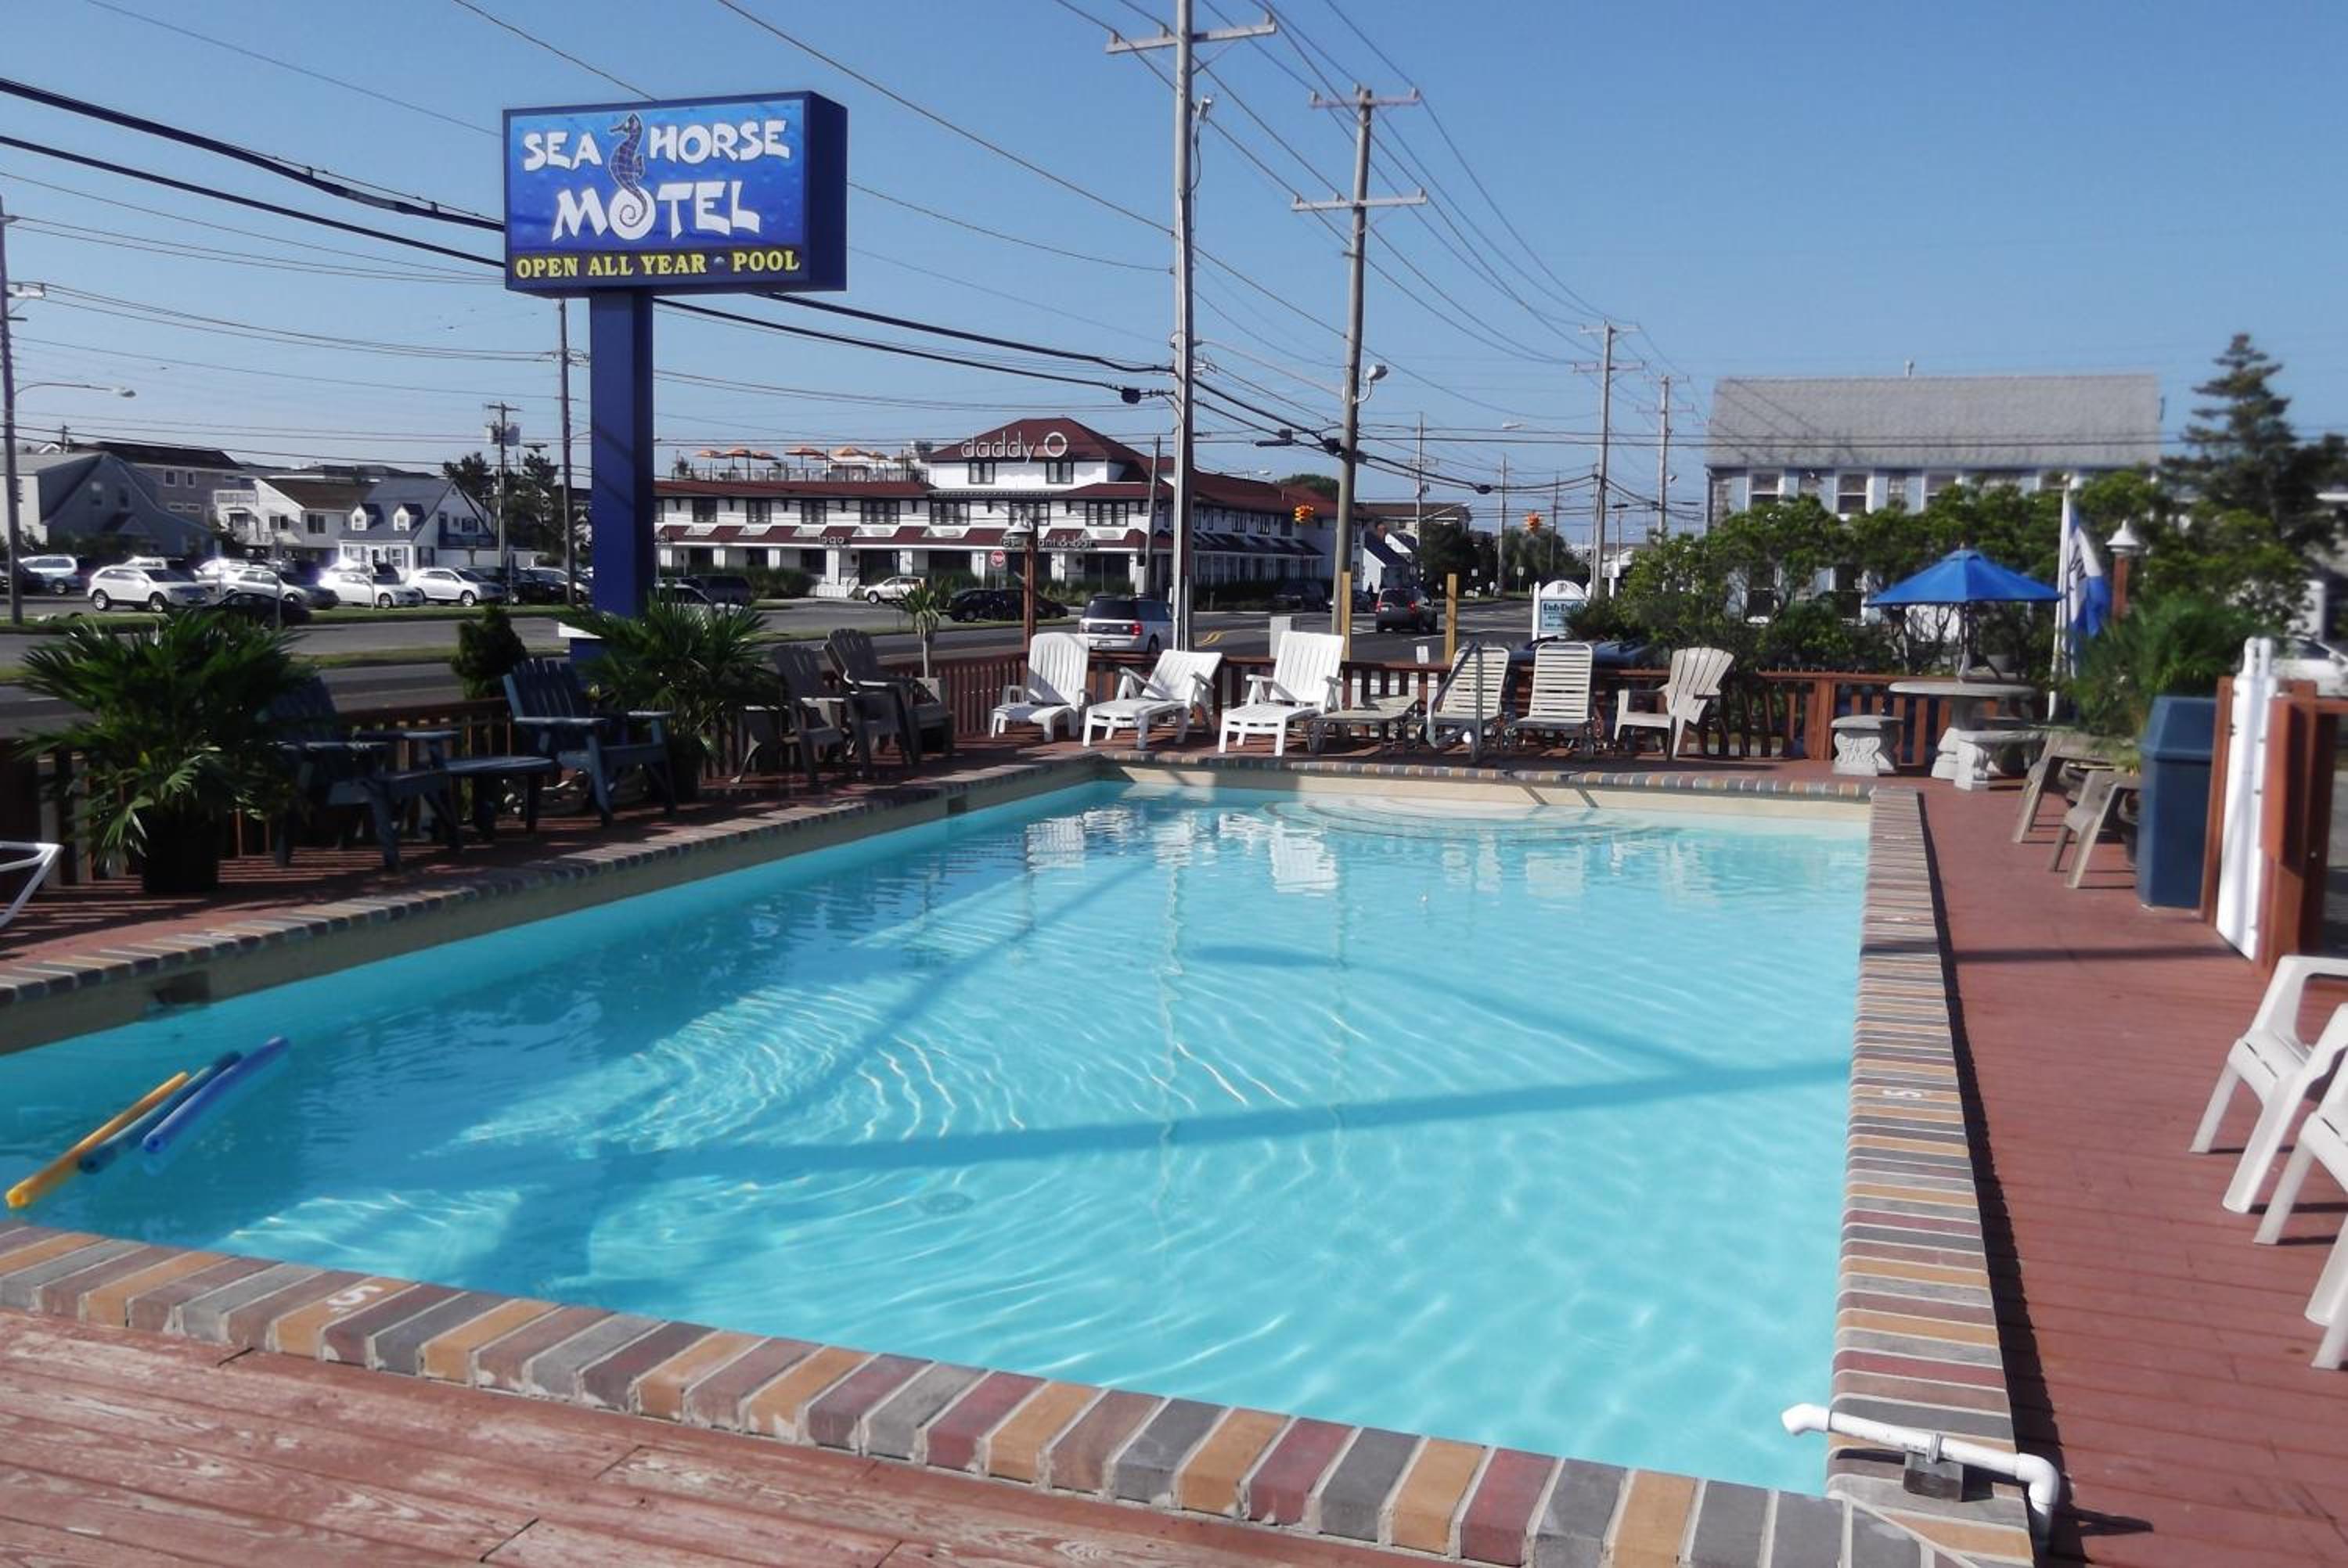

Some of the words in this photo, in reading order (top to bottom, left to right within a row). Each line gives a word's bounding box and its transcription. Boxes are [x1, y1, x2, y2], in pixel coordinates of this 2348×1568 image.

[523, 131, 603, 171] SEA
[650, 119, 790, 164] HORSE
[551, 181, 761, 243] MOTEL
[516, 257, 578, 279] OPEN
[587, 255, 633, 277] ALL
[641, 253, 707, 275] YEAR
[732, 250, 800, 272] POOL
[960, 430, 1036, 465] daddy
[1043, 431, 1068, 458] O
